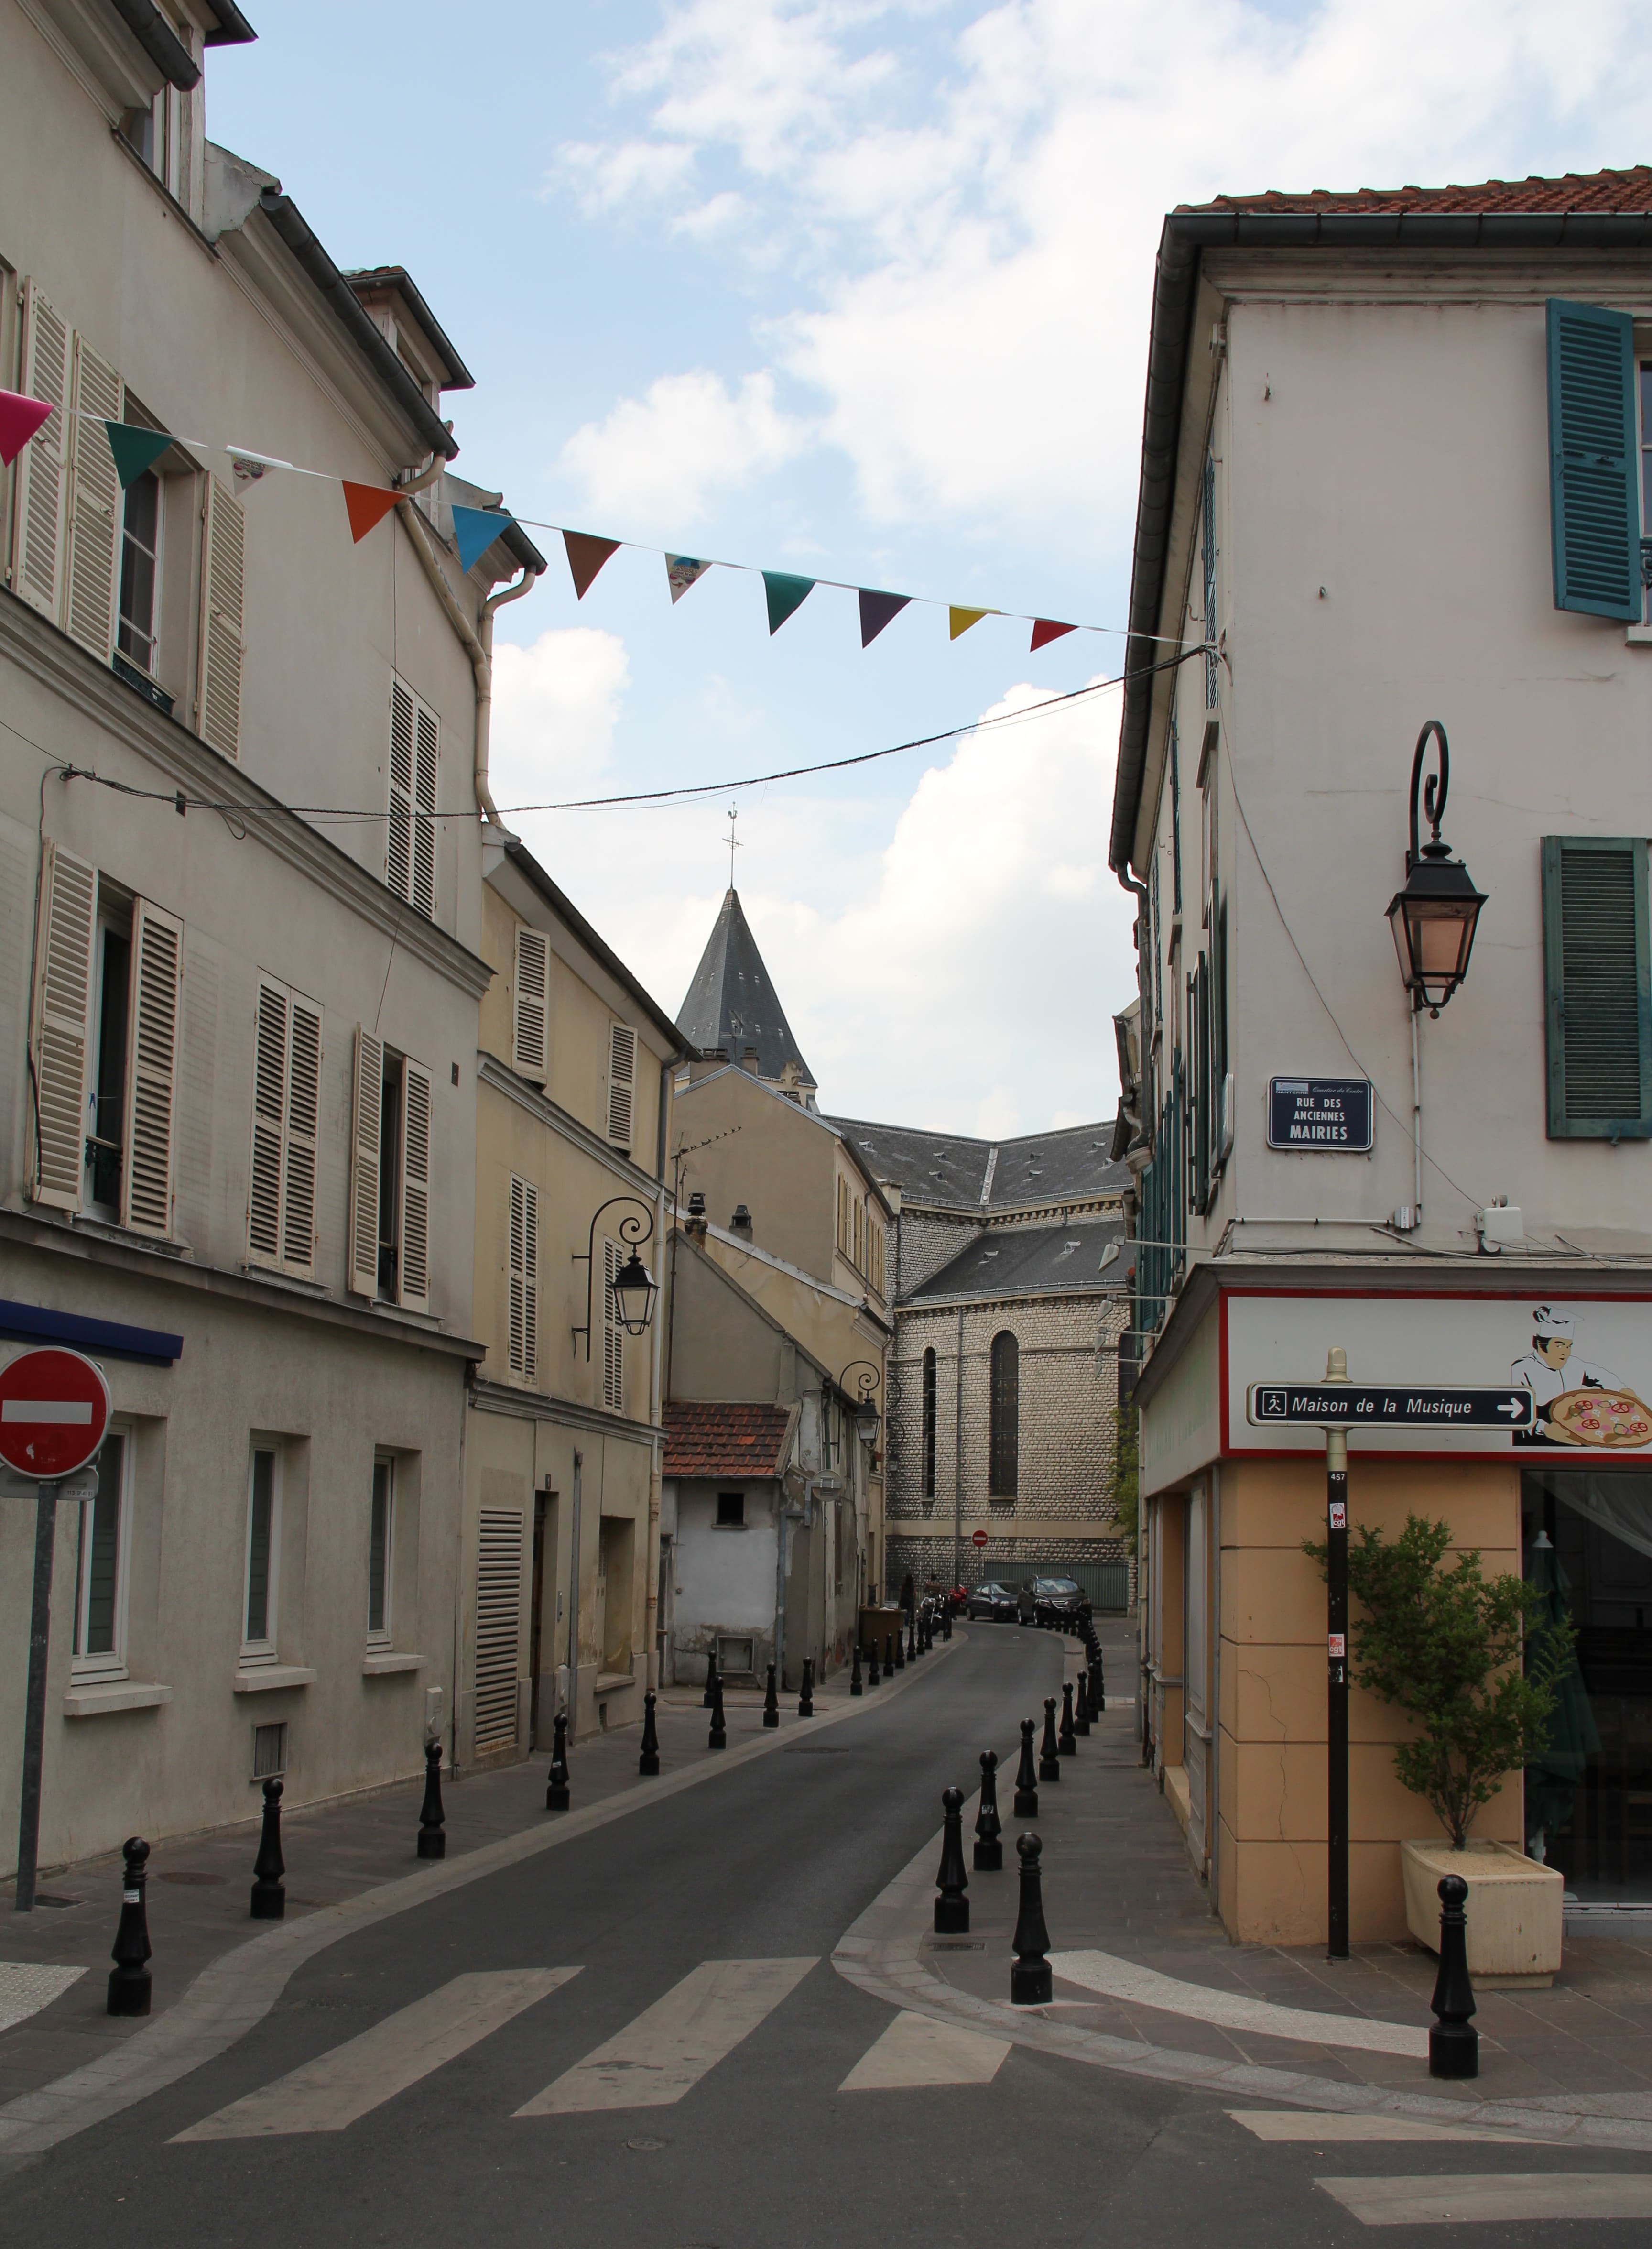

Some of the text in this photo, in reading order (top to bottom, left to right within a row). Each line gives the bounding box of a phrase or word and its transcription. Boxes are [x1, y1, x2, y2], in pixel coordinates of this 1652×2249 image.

[1296, 1097, 1341, 1108] RUE DES
[1293, 1111, 1345, 1121] ANCIENNES
[1290, 1125, 1348, 1140] MAIRIES
[1292, 1397, 1472, 1418] Maison de la Musique
[1329, 1645, 1342, 1654] cgt
